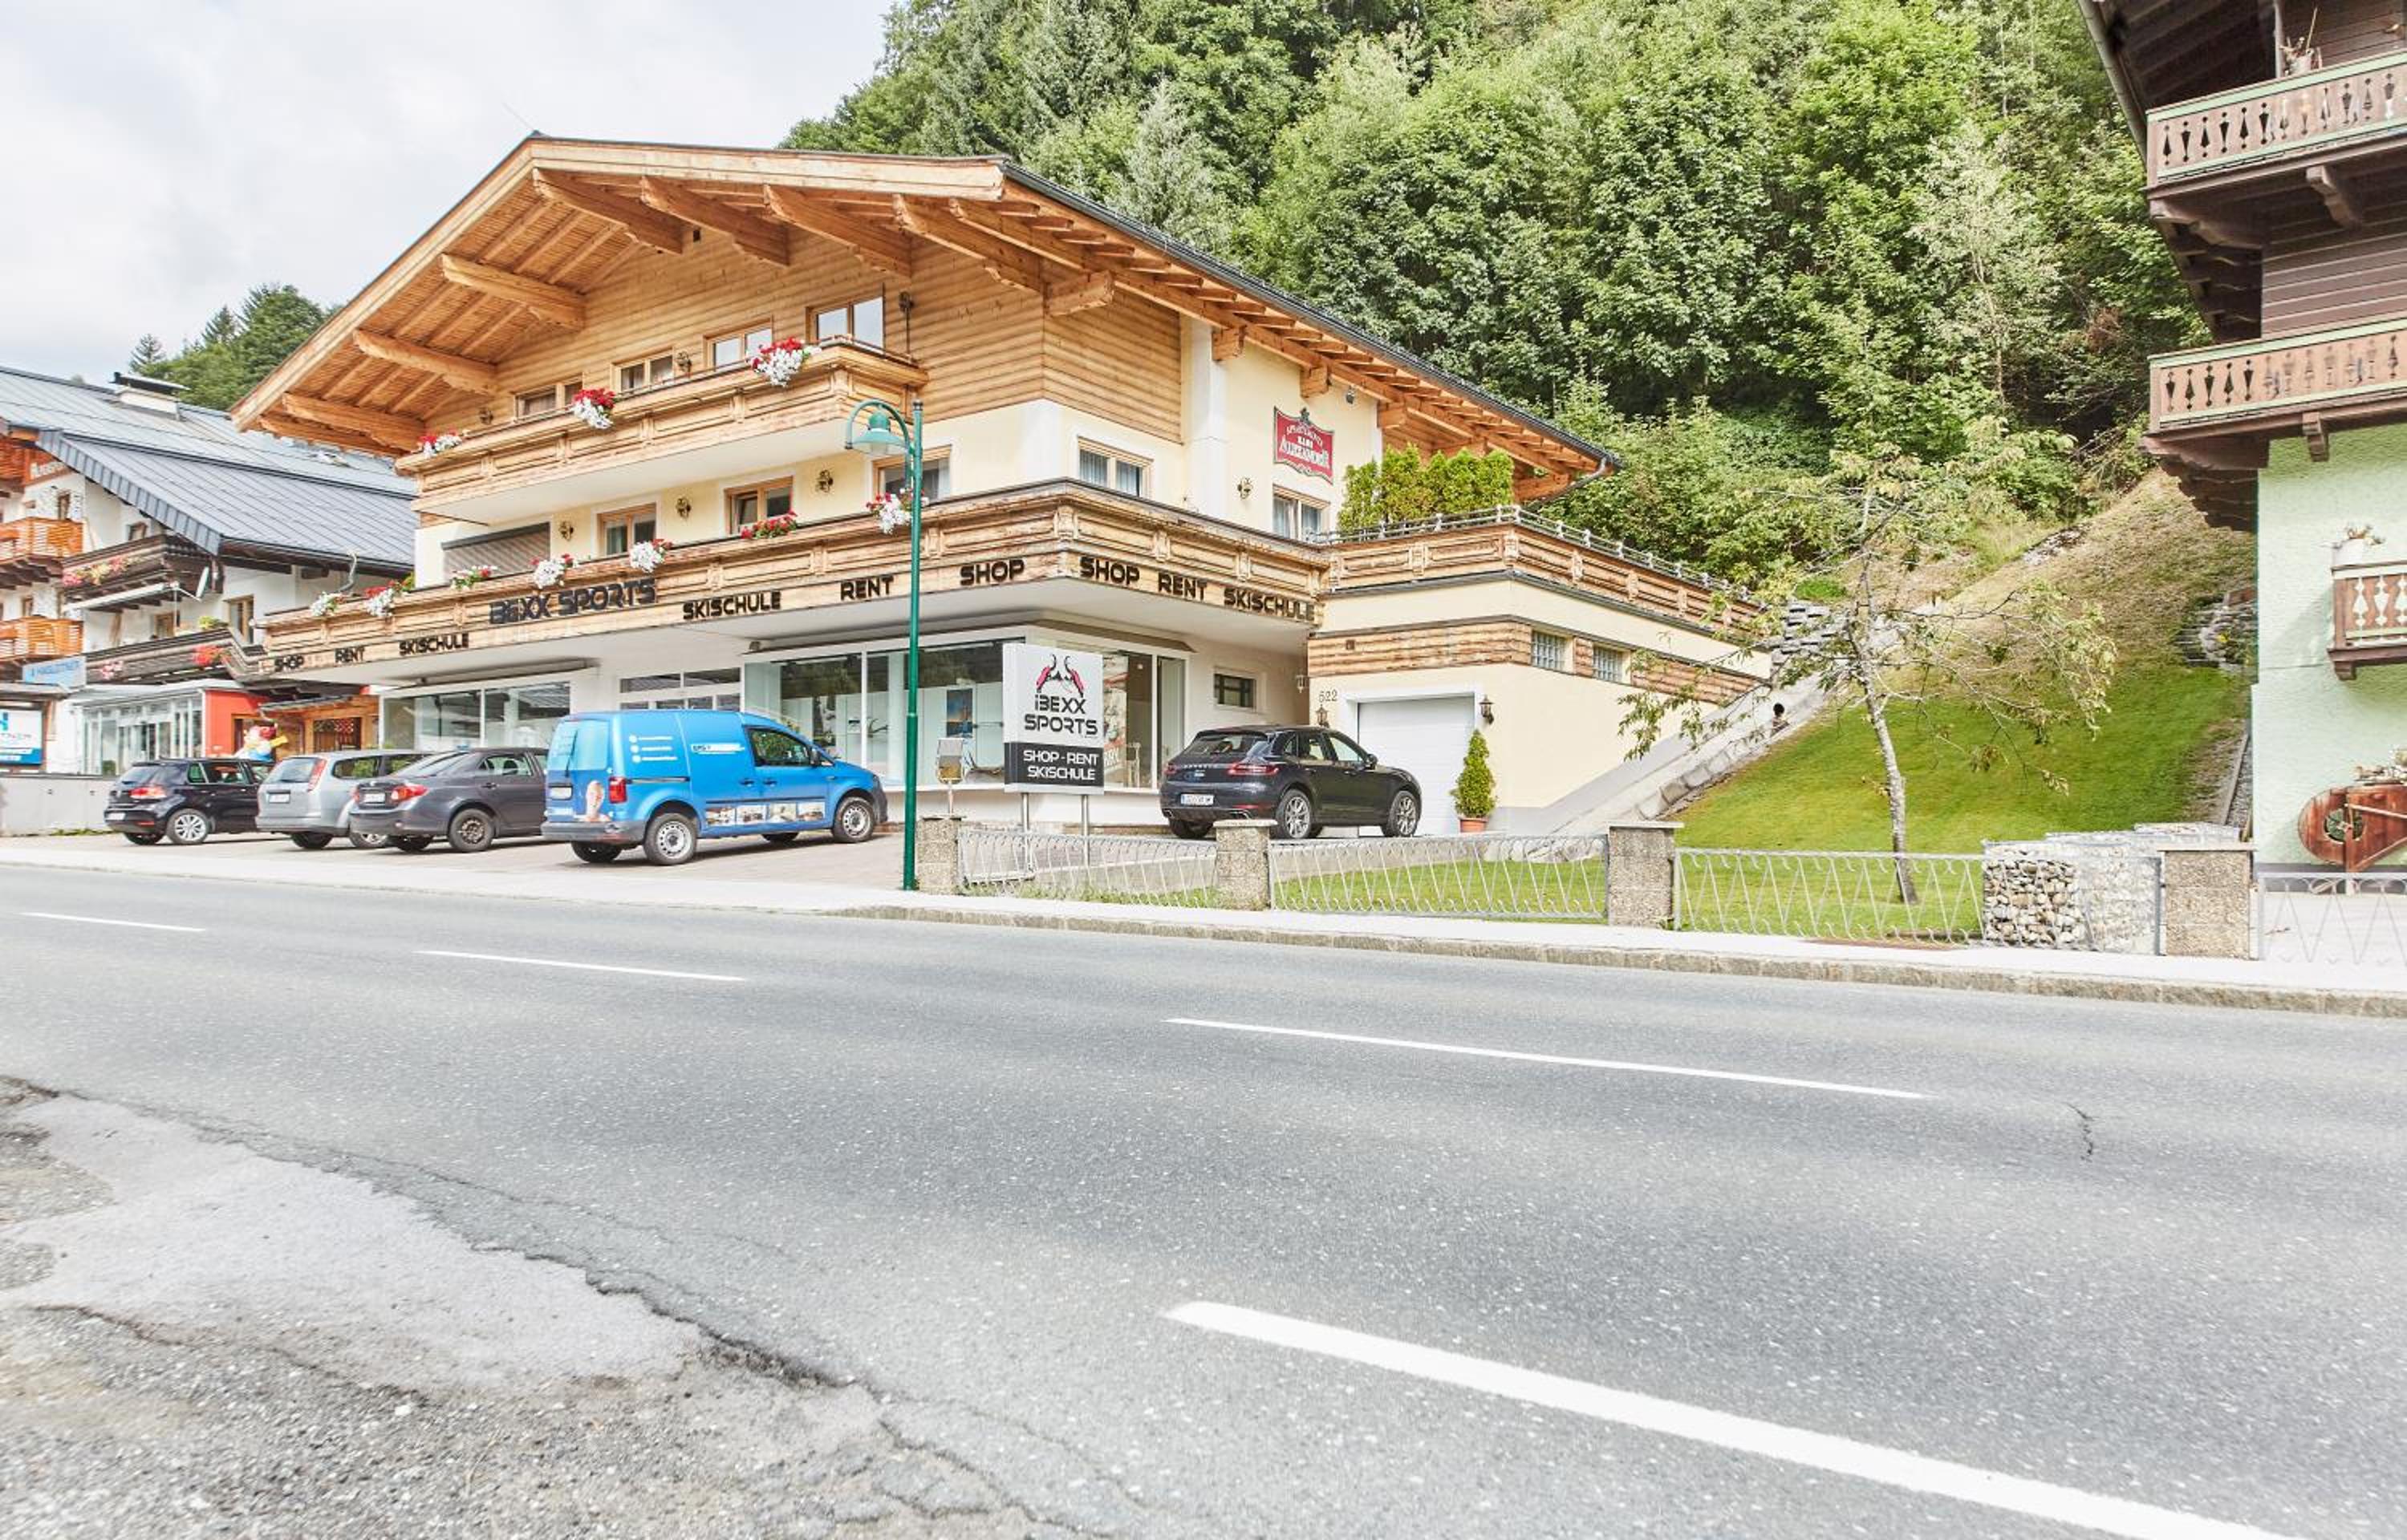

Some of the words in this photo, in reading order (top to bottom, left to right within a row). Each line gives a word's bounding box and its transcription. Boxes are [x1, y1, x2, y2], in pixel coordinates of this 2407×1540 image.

[558, 578, 656, 615] SPORTS
[682, 591, 781, 620] SKISCHULE
[841, 574, 894, 601] RENT
[960, 559, 1025, 586] SHOP
[1080, 556, 1140, 586] SHOP
[1158, 572, 1208, 601] RENT
[1224, 586, 1316, 622] SKISCHULE
[274, 654, 305, 671] SHOP
[335, 646, 365, 663] RENT
[399, 633, 469, 656] SKISCHULE
[1319, 689, 1338, 703] 522
[1025, 713, 1098, 736] SPORTS
[1023, 750, 1060, 763] SHOP
[1067, 752, 1100, 766] RENT
[1027, 765, 1096, 780] SKISCHULE
